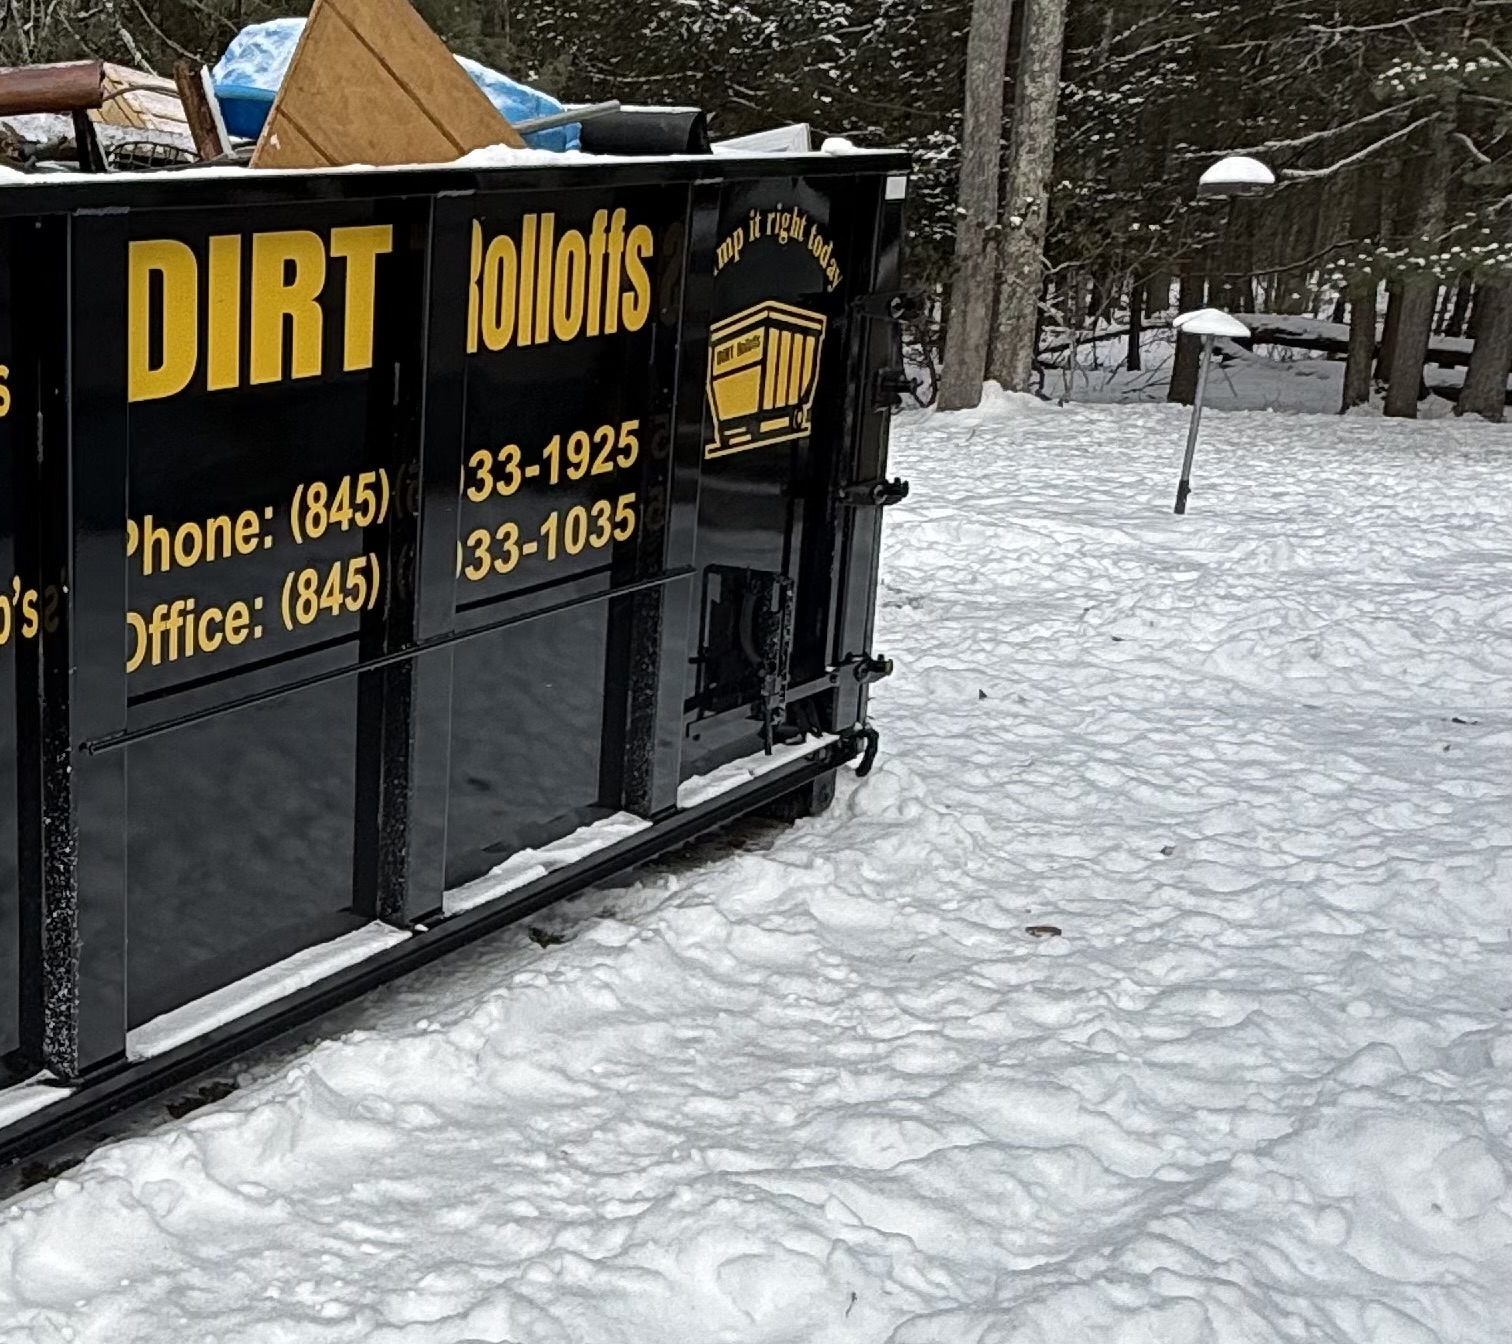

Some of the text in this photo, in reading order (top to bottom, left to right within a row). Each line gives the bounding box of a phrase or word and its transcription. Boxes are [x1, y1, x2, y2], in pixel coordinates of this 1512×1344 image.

[713, 202, 844, 293] mp it right today
[127, 223, 394, 403] DIRT
[290, 468, 391, 542] (845)
[460, 419, 640, 504] 33-1925
[280, 554, 381, 630] (845)
[455, 492, 637, 582] 33-1035
